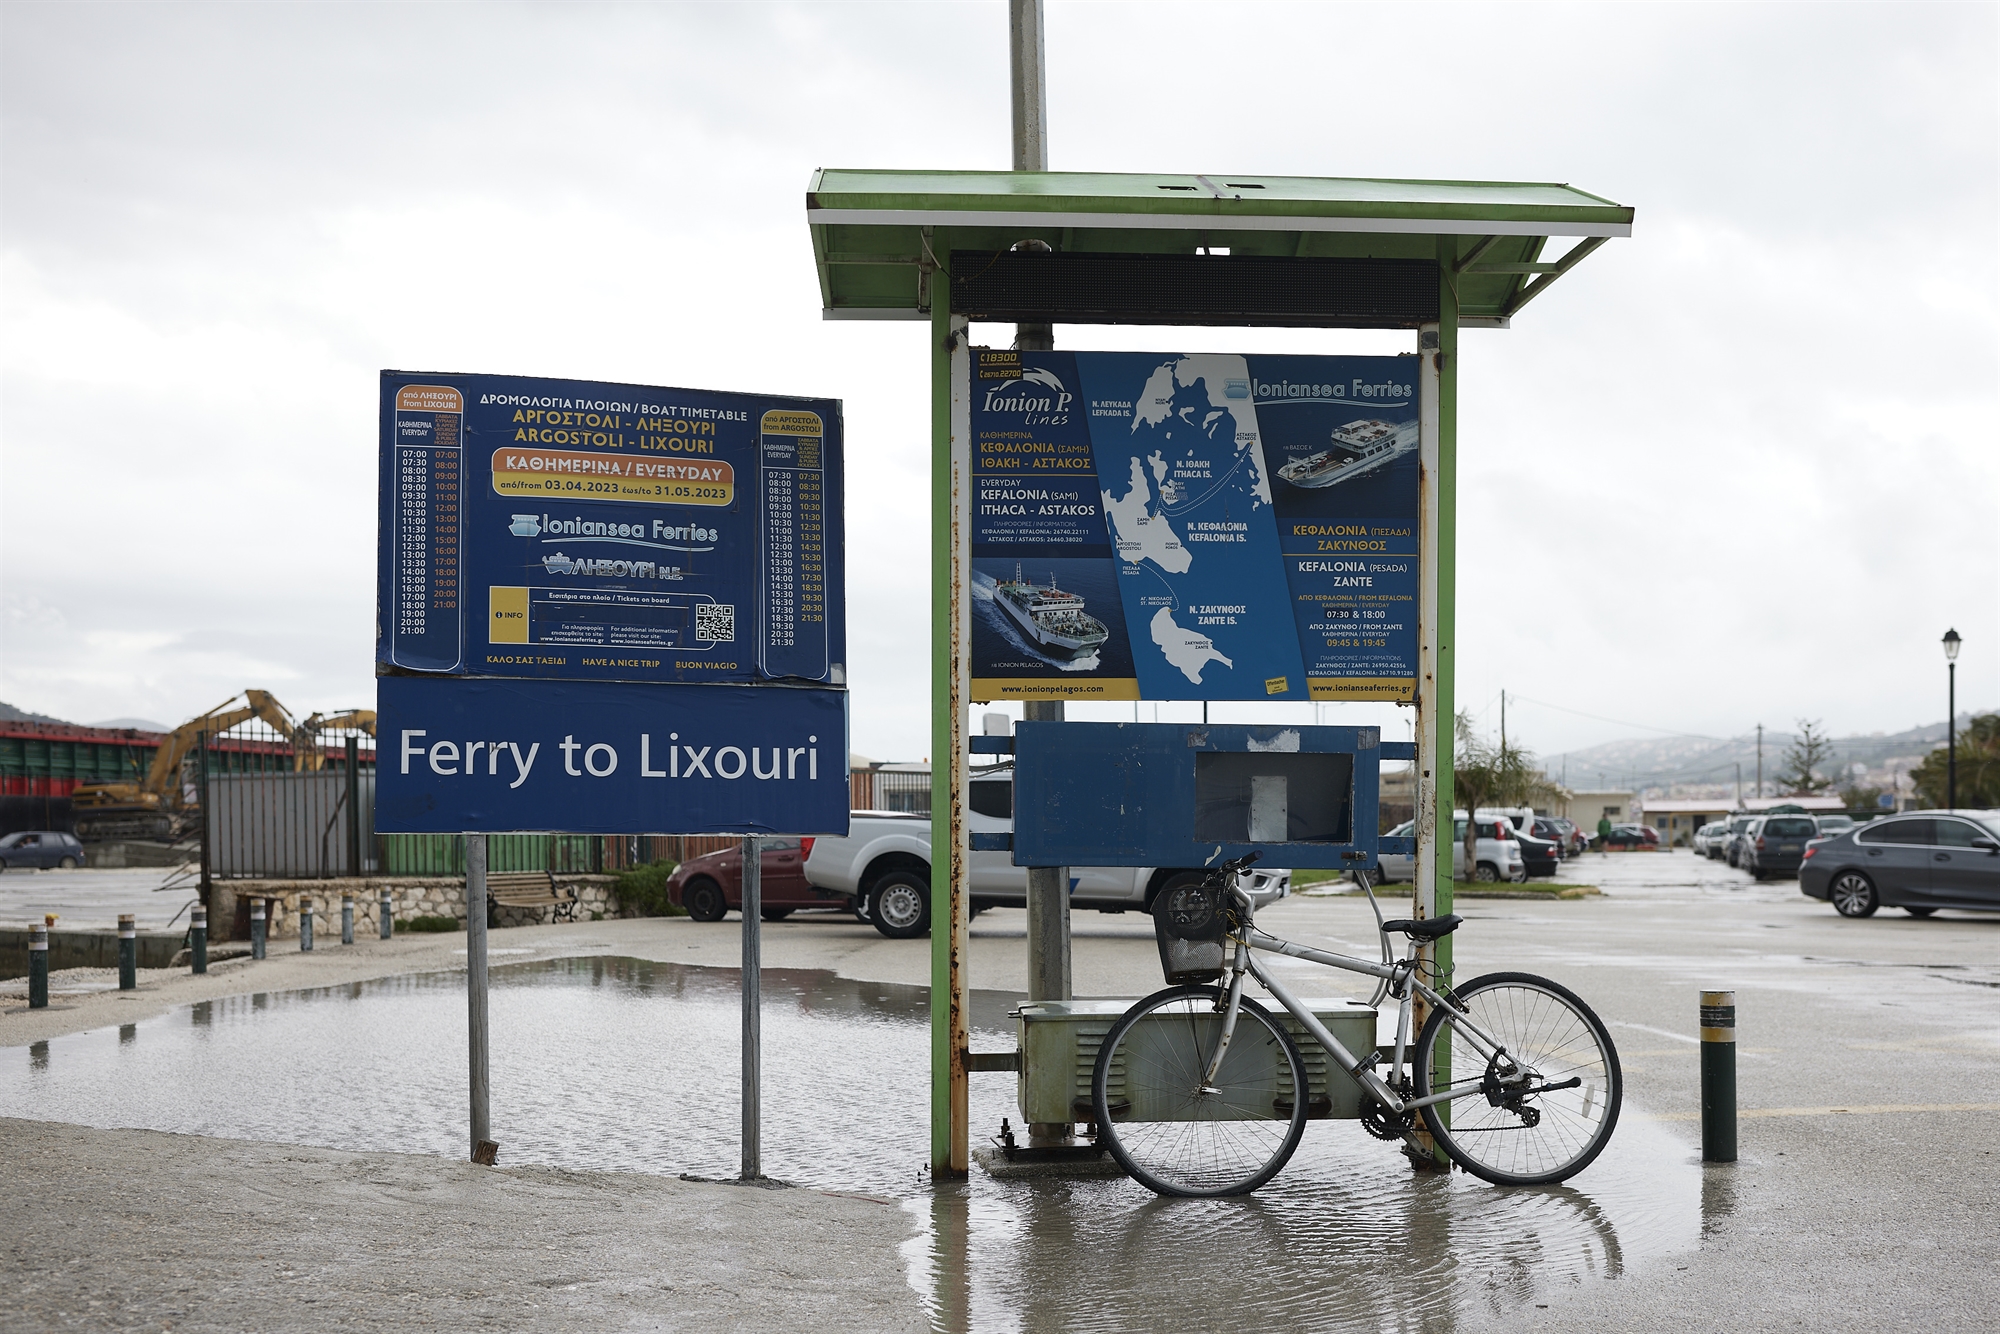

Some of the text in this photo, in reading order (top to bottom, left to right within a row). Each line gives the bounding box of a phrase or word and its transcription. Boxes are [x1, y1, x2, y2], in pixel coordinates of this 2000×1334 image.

[986, 354, 1017, 362] 18300
[1253, 378, 1412, 397] Ioniansea Ferries
[982, 391, 1073, 412] Ionion P.
[480, 394, 748, 421] ΔΡΟΜΟΛΟΓΙΑ ΠΛΟΙΩΝ BOAT TIMETABLE
[513, 410, 716, 435] ΑΡΓΟΣΤΟΛΙ ΛΗΞΟΥΡΙ
[1025, 412, 1068, 425] lines
[515, 428, 713, 453] ARGOSTOLI LIXOURI
[980, 443, 1089, 454] ΚΕΦΑΛΟΝΙΑ (ΣΑΜΗ)
[506, 455, 723, 481] ΚΑΘΗΜΕΡΙΝΑ EVERYDAY
[982, 458, 1090, 468] ΙΘΑΚΗ ΑΣΤΑΚΟΣ
[545, 480, 618, 493] 03.04.2023
[655, 486, 726, 498] 31.05.2023
[981, 490, 1078, 501] KEFALONIA (SAMI)
[981, 505, 1095, 515] ITHACA ASTAKOS
[542, 514, 718, 542] Ioniansea Ferries
[1198, 523, 1247, 531] ΚΕΦΑΛΟΝΙΑ
[1294, 526, 1410, 536] ΚΕΦΑΛΟΝΙΑ (ΠΕΣΑΔΑ)
[1189, 534, 1234, 542] KEFALONIA
[1318, 541, 1386, 551] ΖΑΚΥΝΘΟΣ
[572, 558, 655, 578] ΛΗΞΟΥΡΙ
[1298, 562, 1407, 573] KEFALONIA (PESADA)
[1334, 577, 1373, 586] ZANTE
[486, 655, 513, 663] ΚΑΛΟ
[536, 657, 566, 665] ΤΑΞΙΔΙ
[582, 658, 607, 666] HAVE
[704, 662, 737, 670] VIAGIO
[1002, 685, 1103, 694] www.ionionpelagos.com
[1313, 684, 1410, 694] www.ionianseaferries.gr
[400, 729, 818, 789] Ferry to Lixouri
